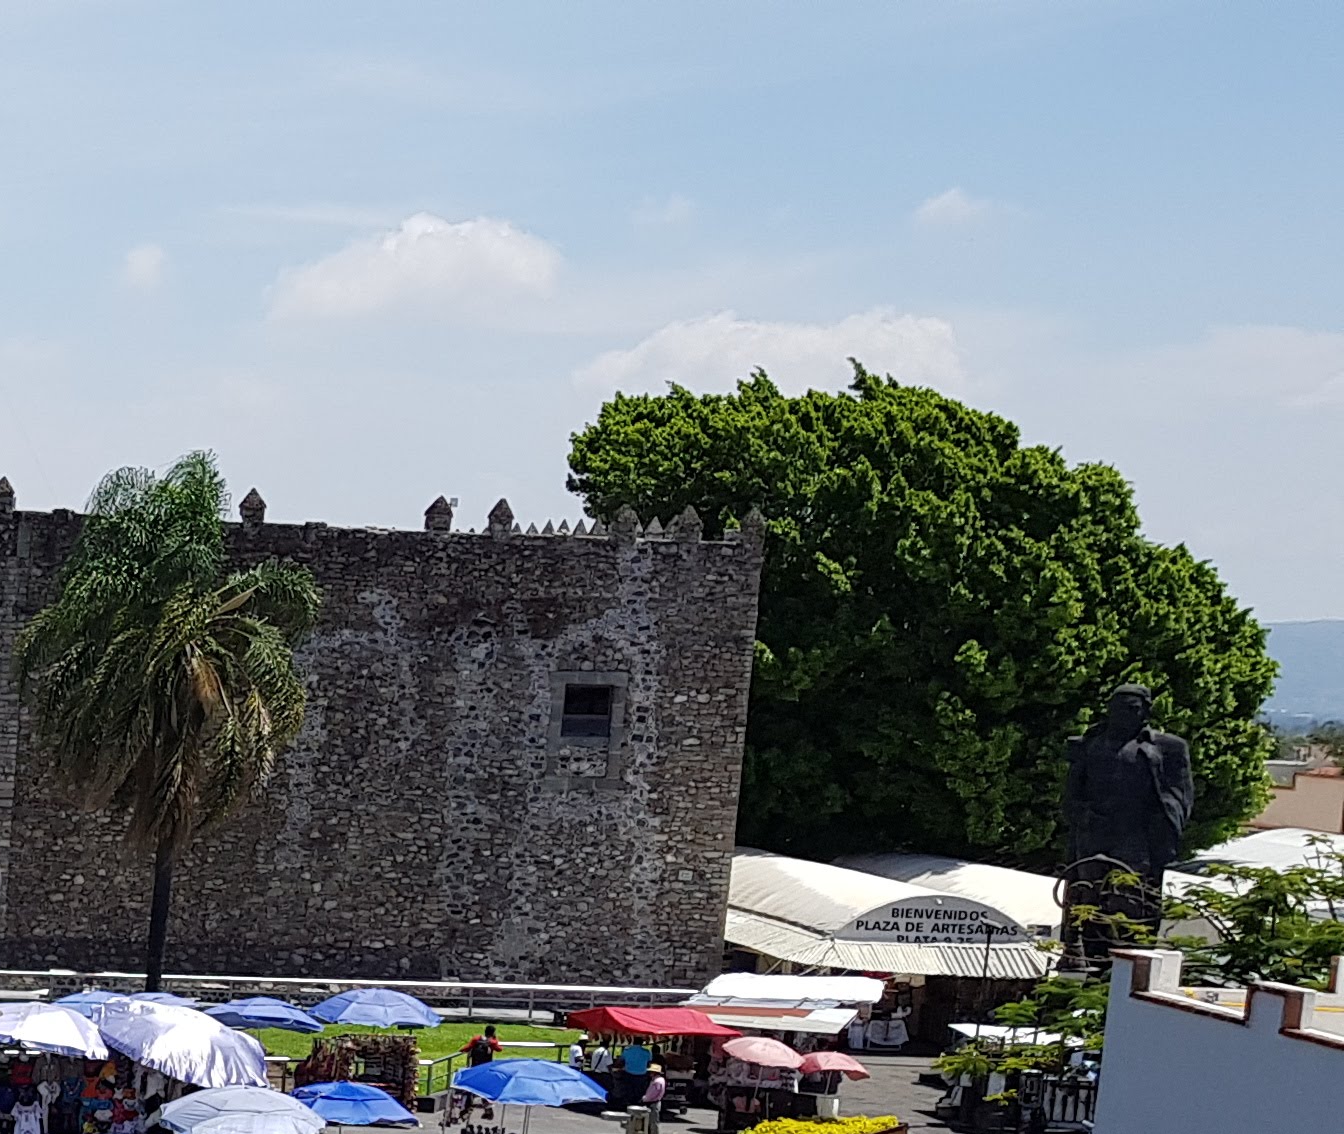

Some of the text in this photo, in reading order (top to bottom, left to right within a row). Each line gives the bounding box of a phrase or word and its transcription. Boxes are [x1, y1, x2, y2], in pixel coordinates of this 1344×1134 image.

[891, 907, 988, 922] BIENVENIDOS
[855, 920, 900, 932] PLAZA
[904, 921, 924, 933] DE
